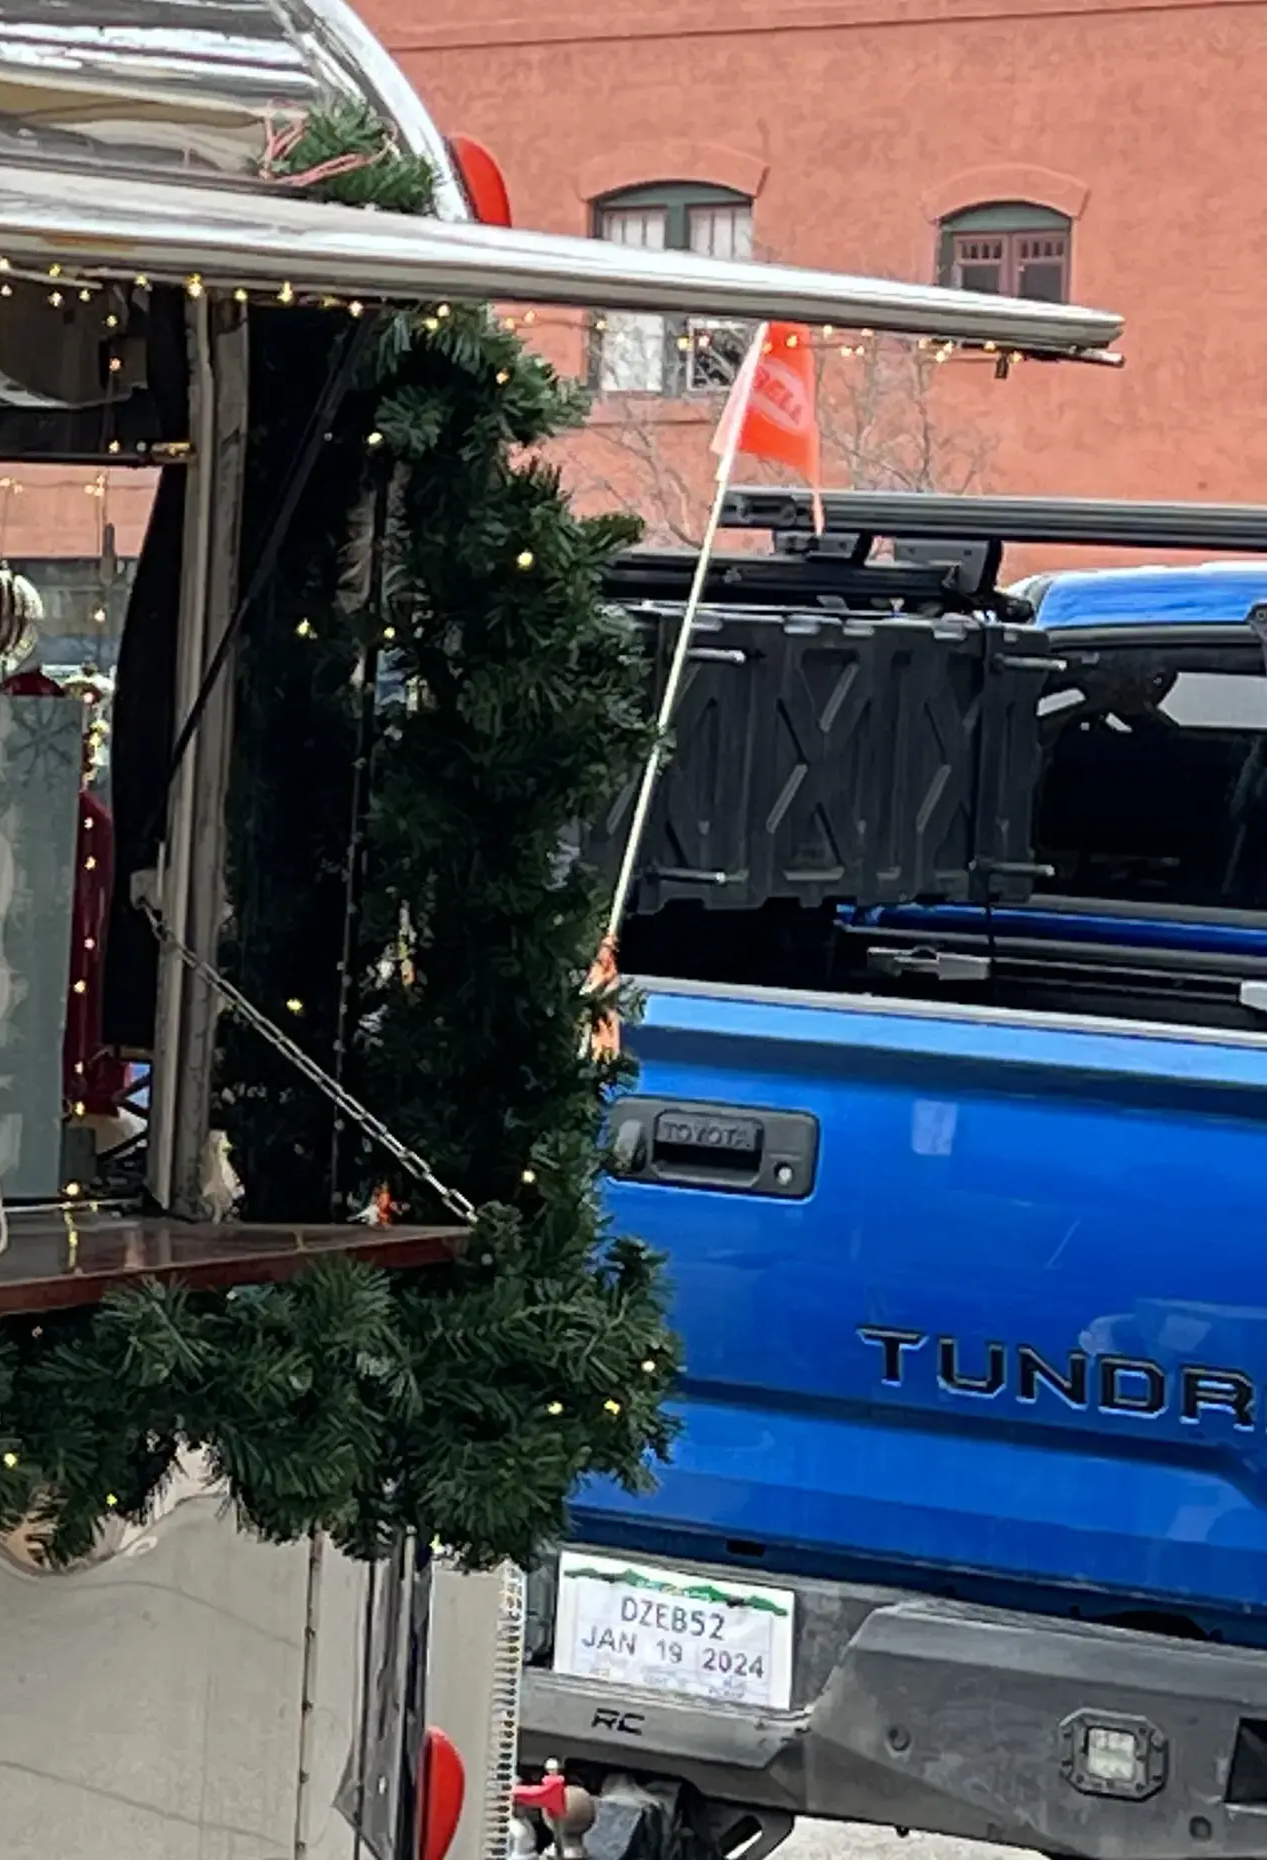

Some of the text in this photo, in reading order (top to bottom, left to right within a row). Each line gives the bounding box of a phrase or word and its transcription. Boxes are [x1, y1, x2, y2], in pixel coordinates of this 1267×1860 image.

[664, 1122, 751, 1147] TOYOTA
[857, 1325, 1267, 1434] TUNDR
[582, 1625, 765, 1680] JAN 19 2024
[590, 1707, 646, 1736] RC
